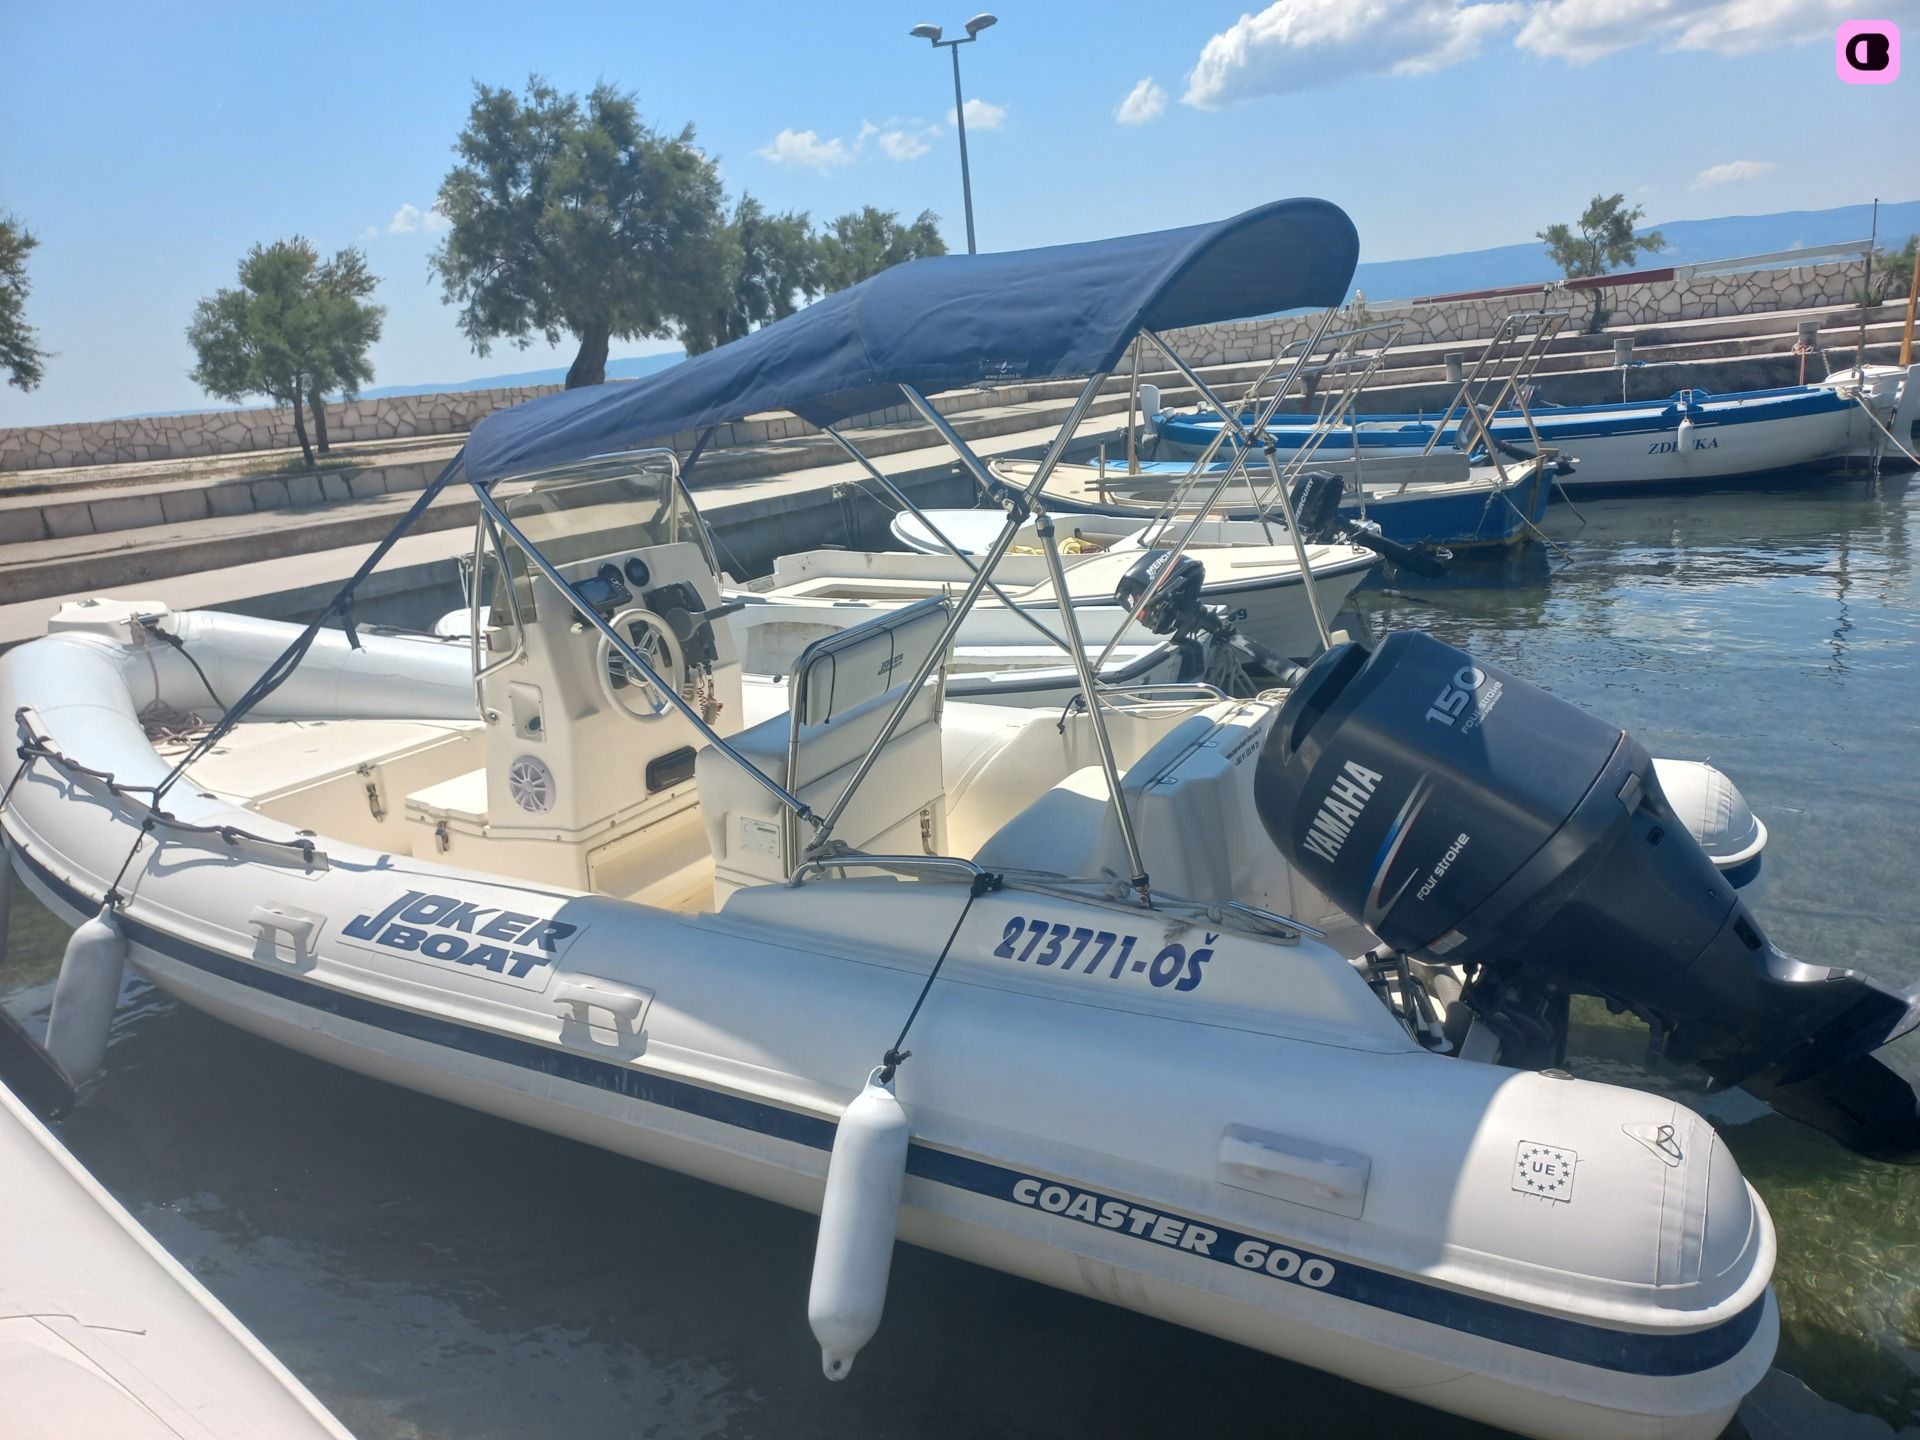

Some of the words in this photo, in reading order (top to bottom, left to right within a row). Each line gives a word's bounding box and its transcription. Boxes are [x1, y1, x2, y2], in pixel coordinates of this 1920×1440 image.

[1648, 437, 1719, 454] ZDKA
[1426, 665, 1487, 727] 150
[1303, 760, 1384, 863] YAMAHA
[341, 889, 577, 952] JOKER
[376, 922, 551, 979] BOAT
[993, 916, 1220, 992] 273771-OŠ
[1532, 1161, 1556, 1176] UE
[1012, 1179, 1218, 1255] COASTER
[1233, 1240, 1335, 1287] 600
